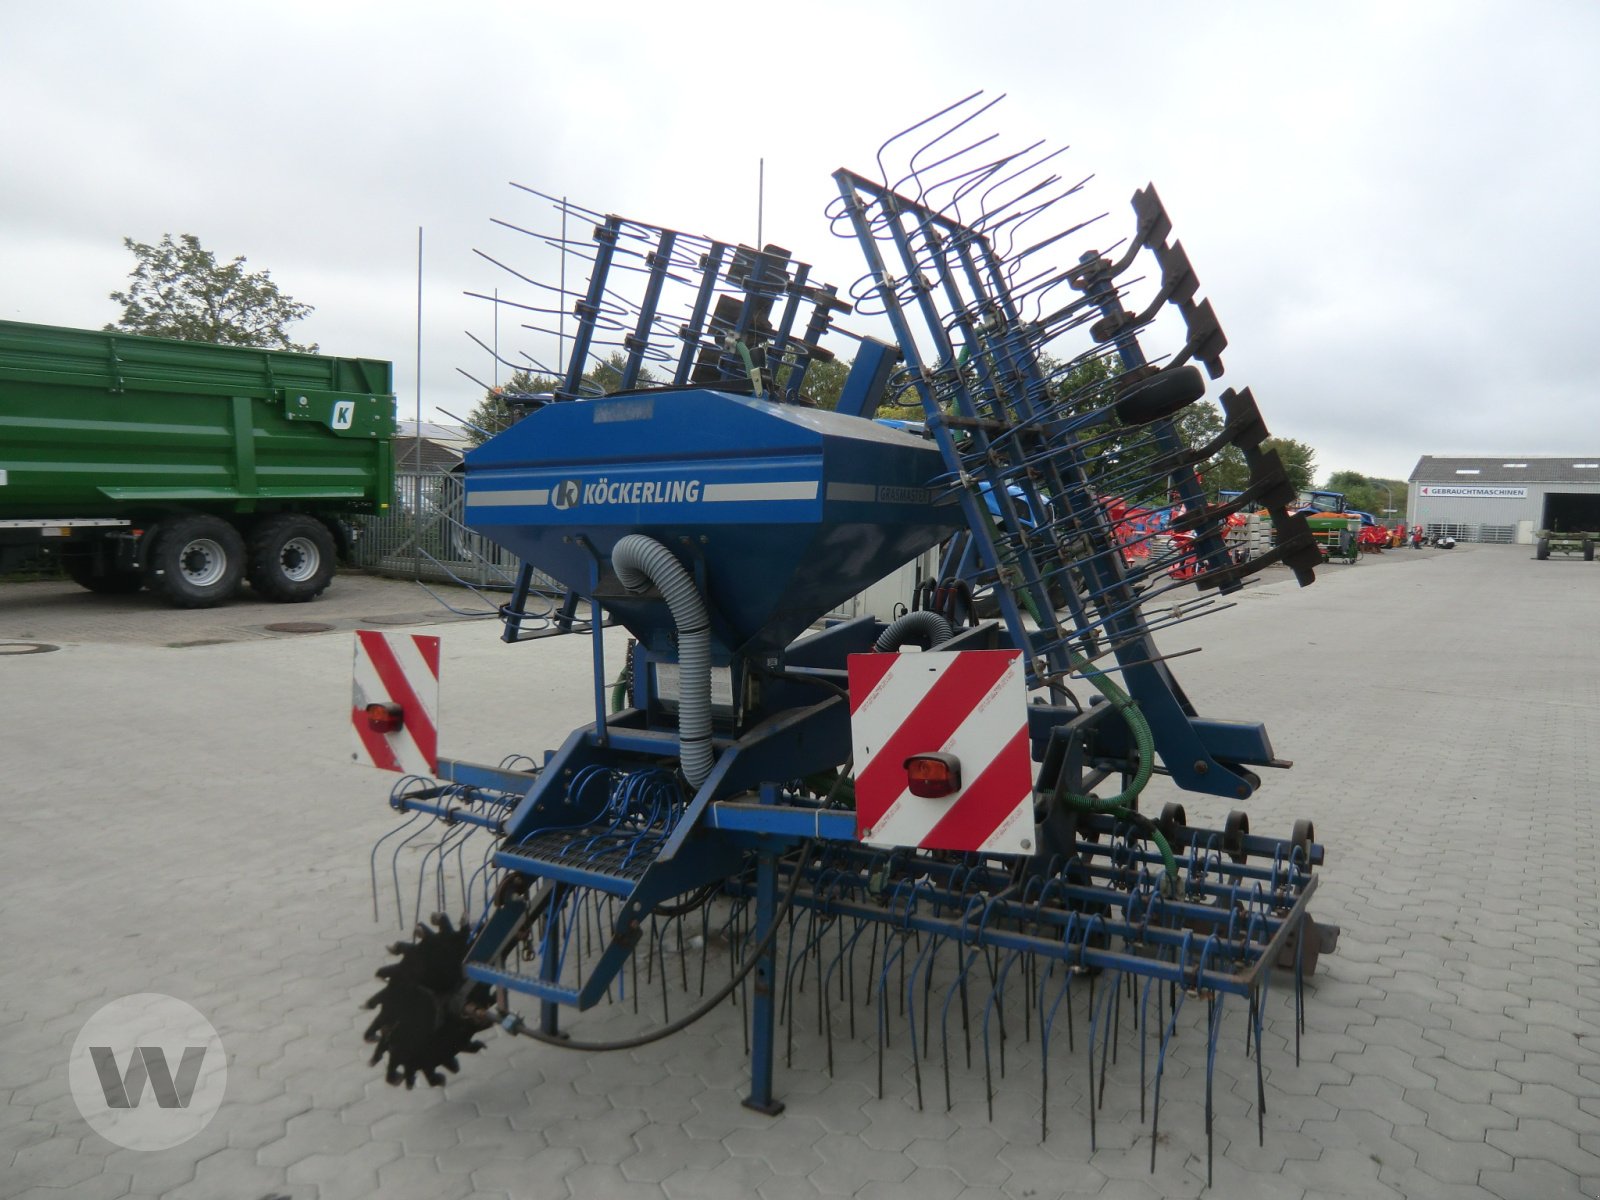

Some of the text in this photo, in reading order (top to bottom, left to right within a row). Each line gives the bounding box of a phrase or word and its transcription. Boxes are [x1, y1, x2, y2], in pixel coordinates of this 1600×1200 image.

[337, 407, 350, 423] K
[583, 478, 700, 505] KÖCKERLING
[1431, 488, 1524, 496] GEBRAUCHTMASCHINEN
